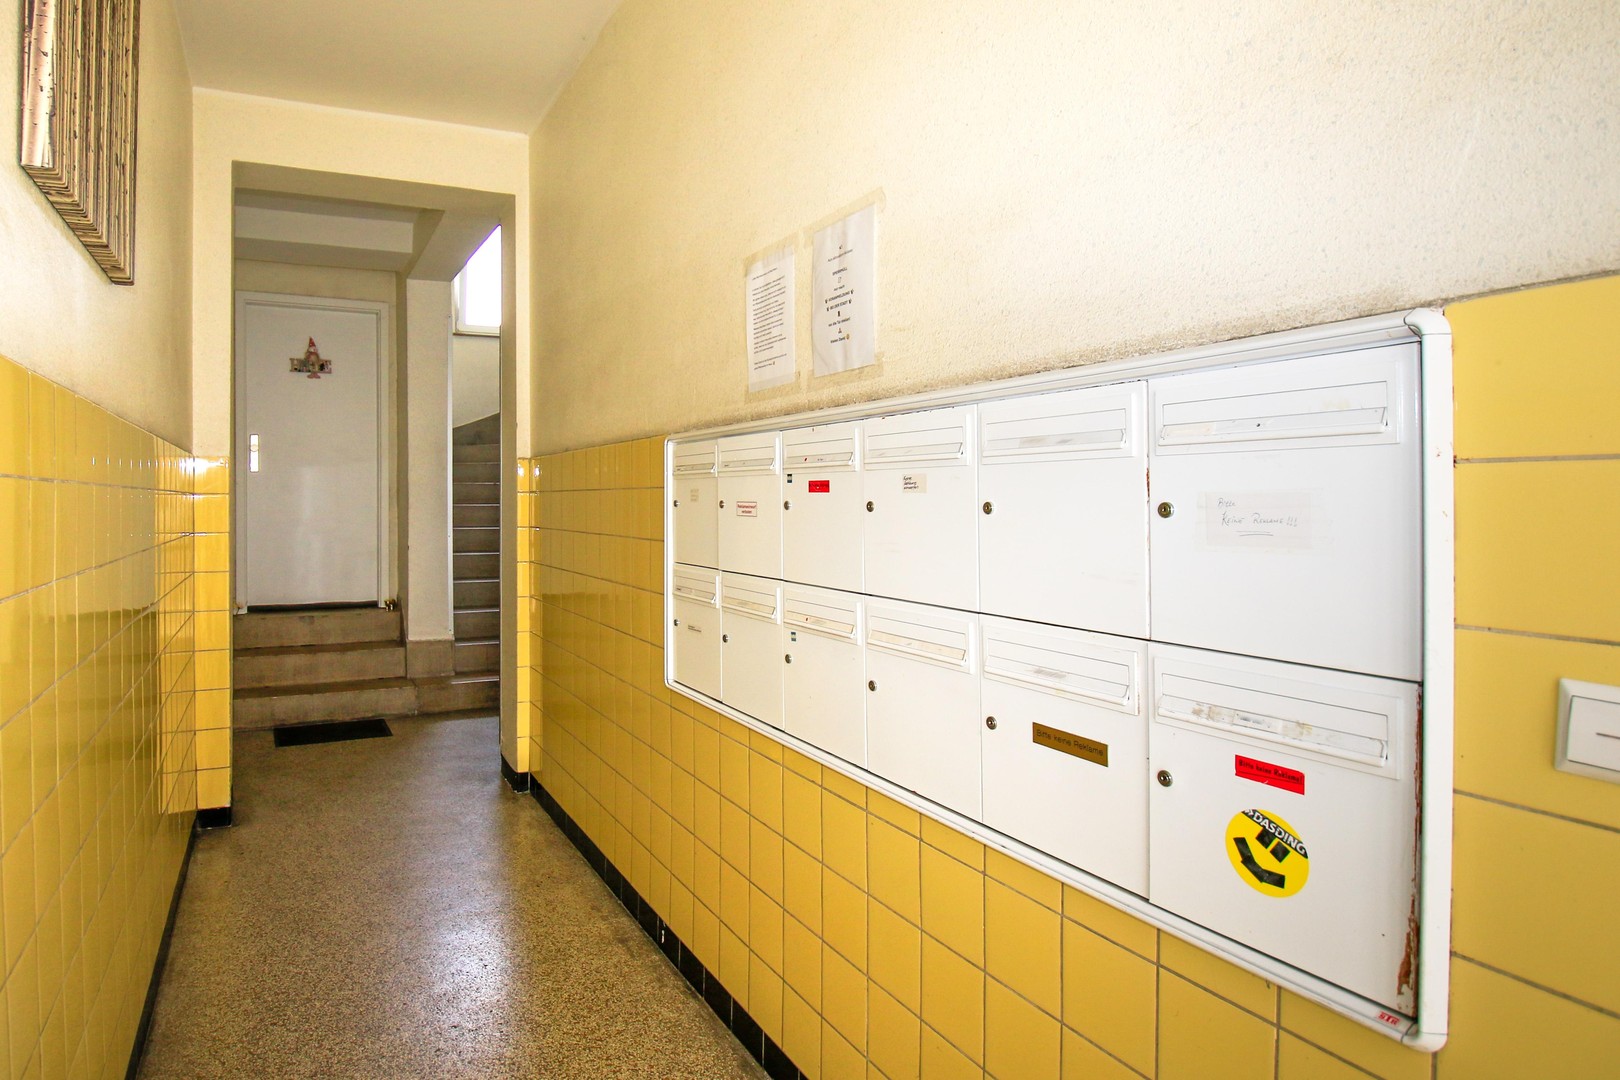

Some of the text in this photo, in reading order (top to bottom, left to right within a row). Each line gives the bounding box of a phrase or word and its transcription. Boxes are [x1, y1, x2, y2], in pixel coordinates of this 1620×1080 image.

[1036, 729, 1104, 756] Bitte keine Reklame
[1255, 763, 1272, 774] keine
